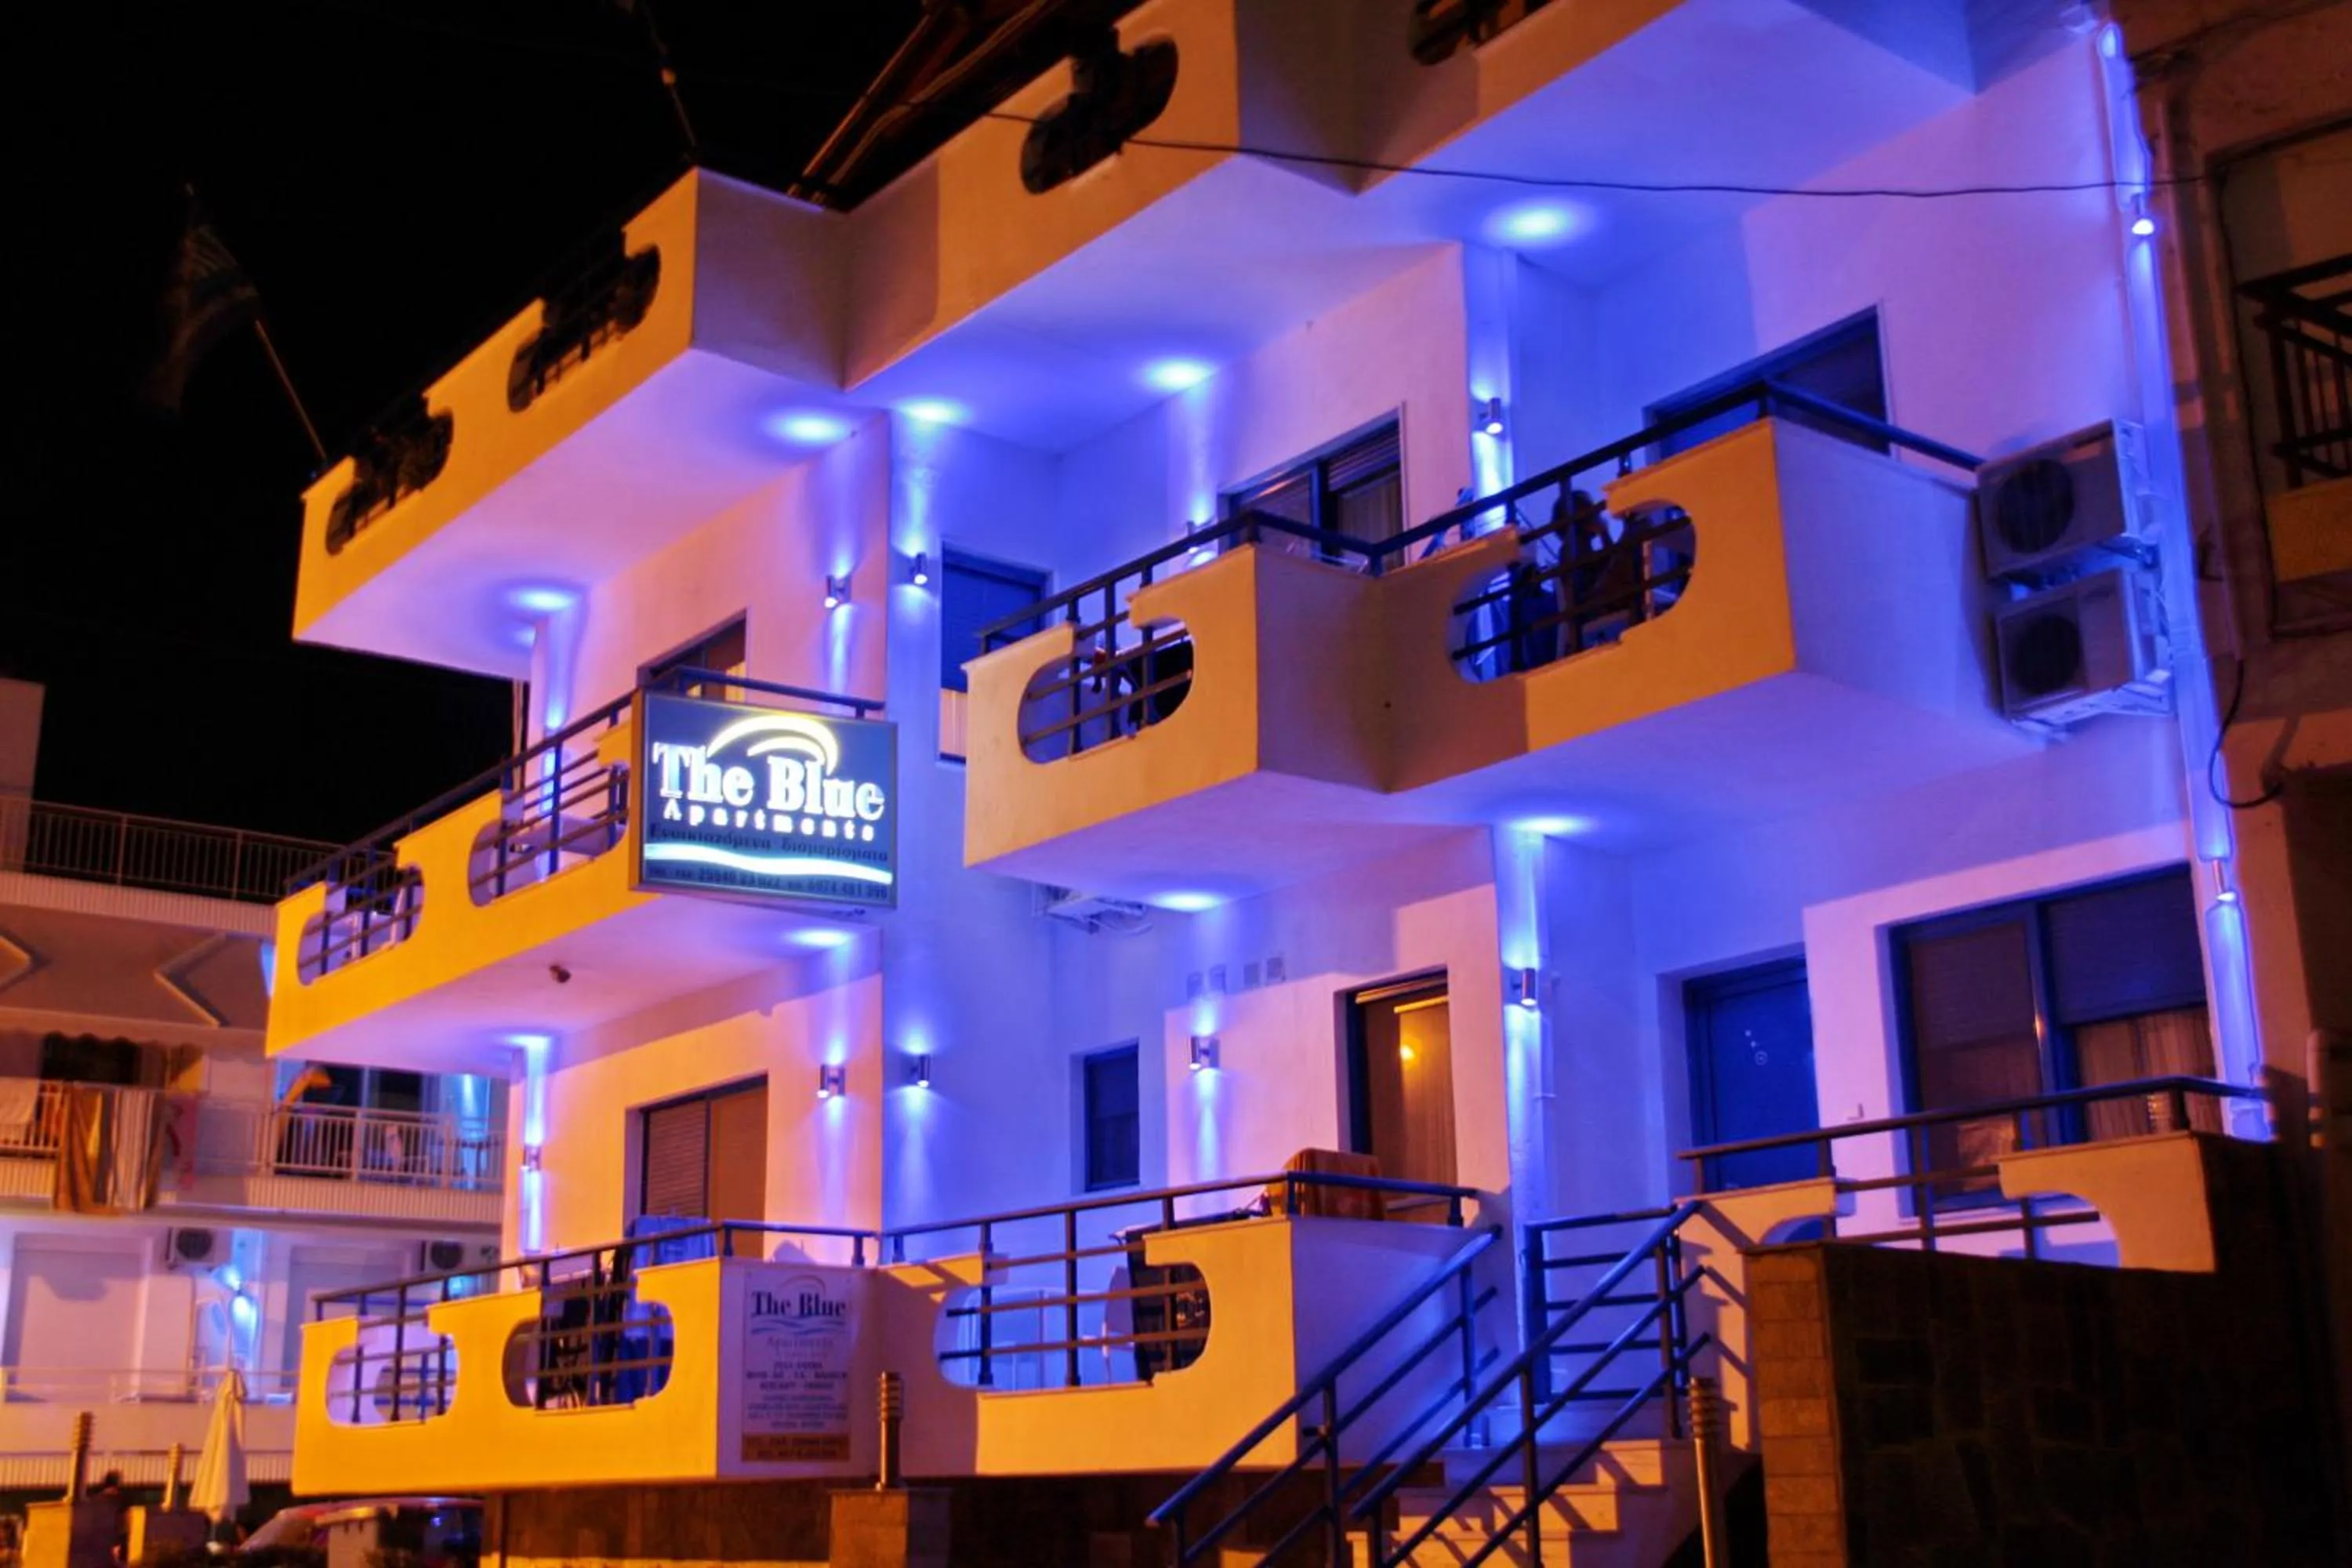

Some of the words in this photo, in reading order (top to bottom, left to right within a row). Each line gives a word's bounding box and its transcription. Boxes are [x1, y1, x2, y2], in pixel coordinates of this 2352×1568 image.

[652, 741, 754, 807] The
[767, 755, 885, 821] Blue
[663, 797, 875, 842] Apartments
[750, 1290, 791, 1317] The
[798, 1292, 847, 1318] Blue
